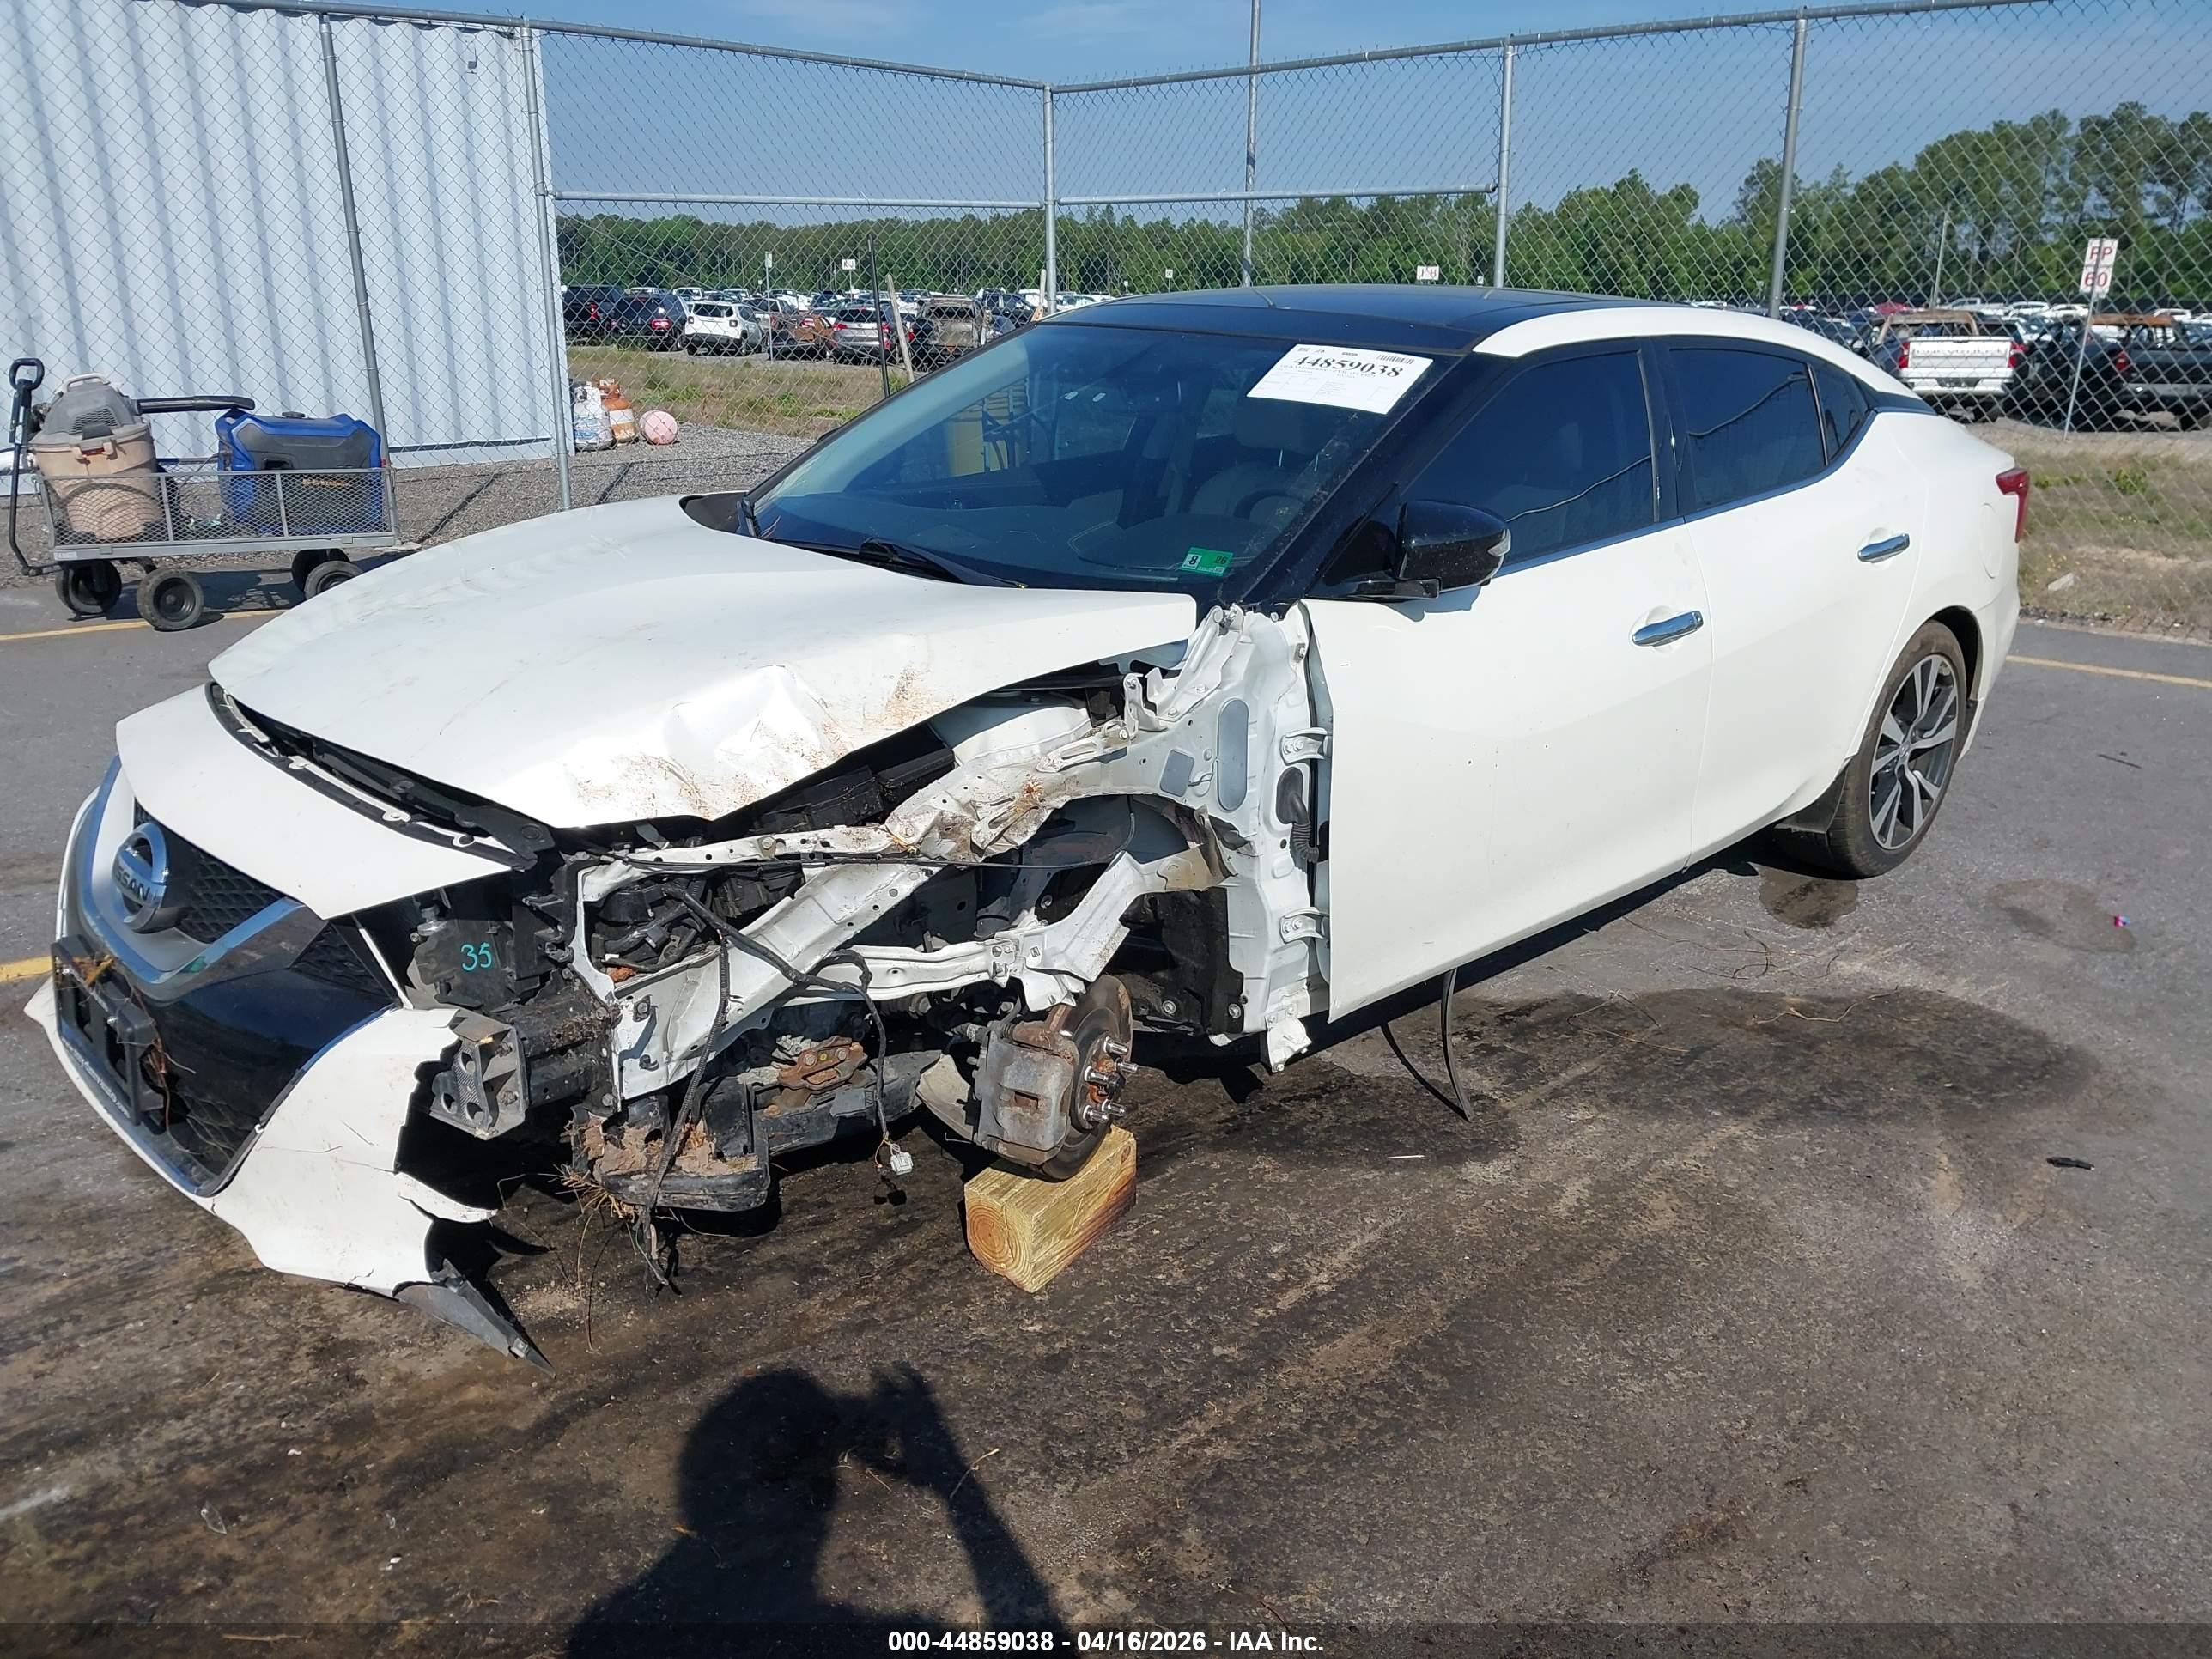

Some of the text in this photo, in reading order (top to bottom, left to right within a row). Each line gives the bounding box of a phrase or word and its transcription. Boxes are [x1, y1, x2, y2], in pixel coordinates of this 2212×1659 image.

[2084, 271, 2107, 288] 60
[1293, 356, 1404, 378] 44859038
[1188, 555, 1199, 565] 8
[460, 942, 492, 971] 35
